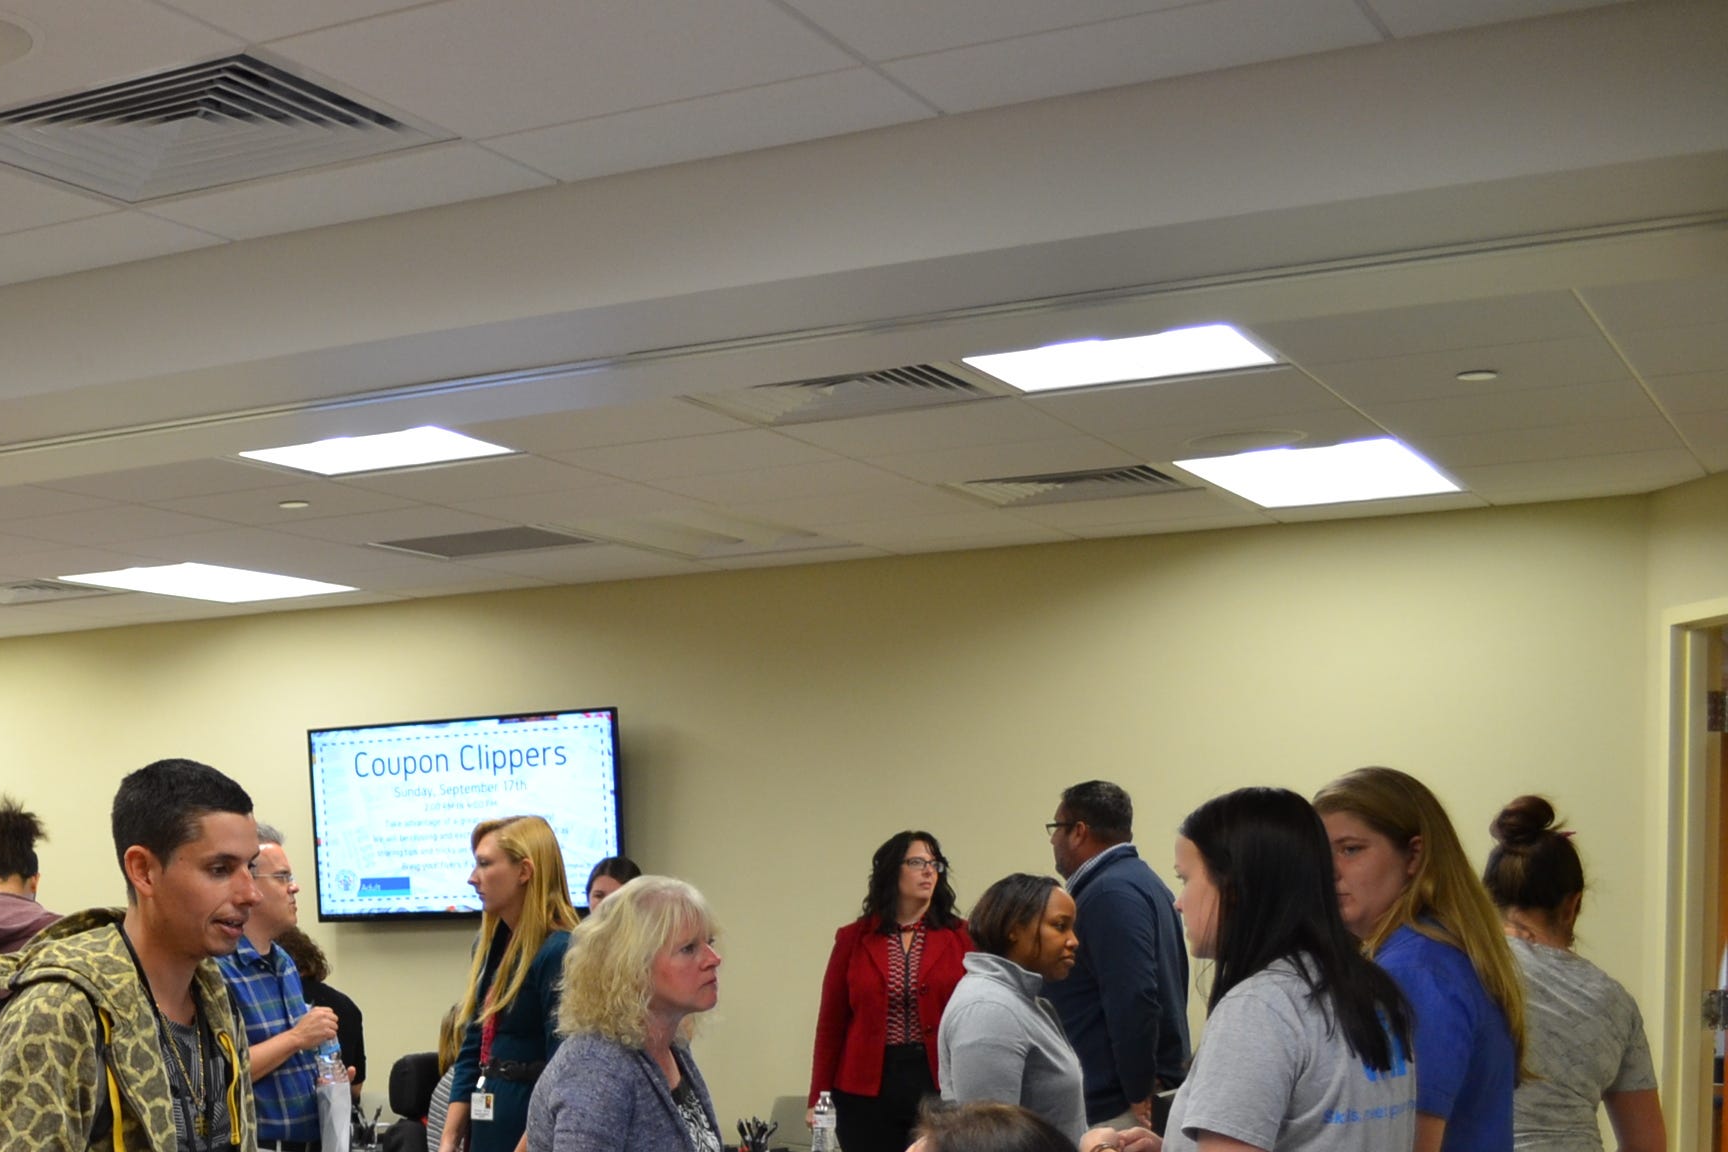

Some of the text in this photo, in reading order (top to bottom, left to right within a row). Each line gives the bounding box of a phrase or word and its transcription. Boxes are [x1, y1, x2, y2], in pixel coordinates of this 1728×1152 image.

[354, 744, 568, 781] Coupon Clippers
[394, 780, 528, 798] Sunday, September 17th
